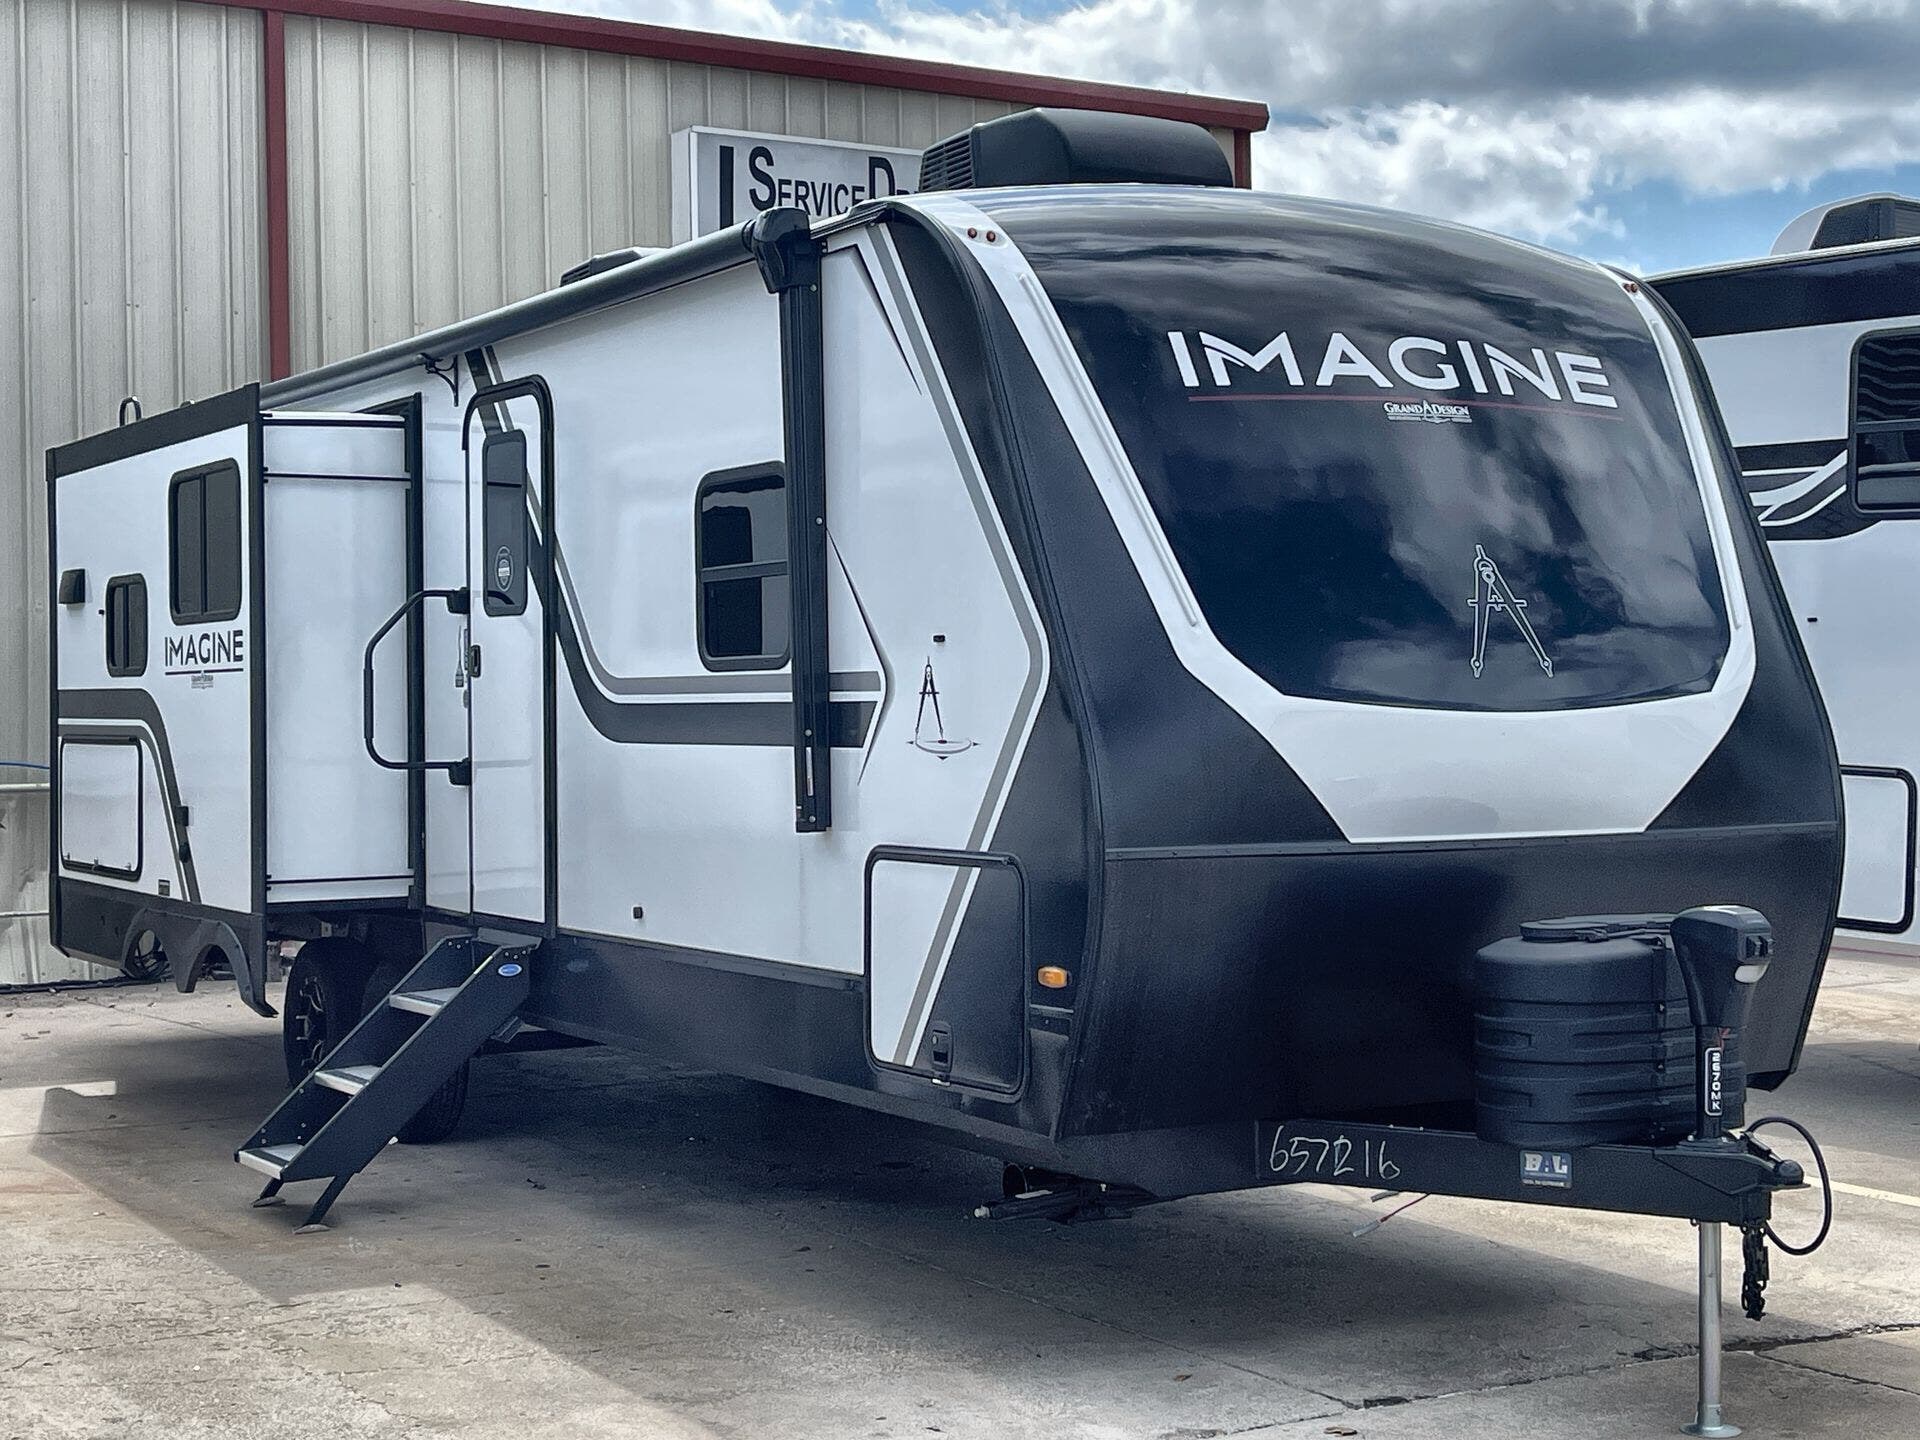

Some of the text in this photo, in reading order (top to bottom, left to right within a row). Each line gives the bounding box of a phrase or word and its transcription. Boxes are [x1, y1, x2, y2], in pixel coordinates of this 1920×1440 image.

[1167, 331, 1619, 408] IMAGINE
[164, 629, 244, 667] IMAGINE
[1710, 1052, 1721, 1110] 2670MK
[1269, 1125, 1401, 1180] 657216
